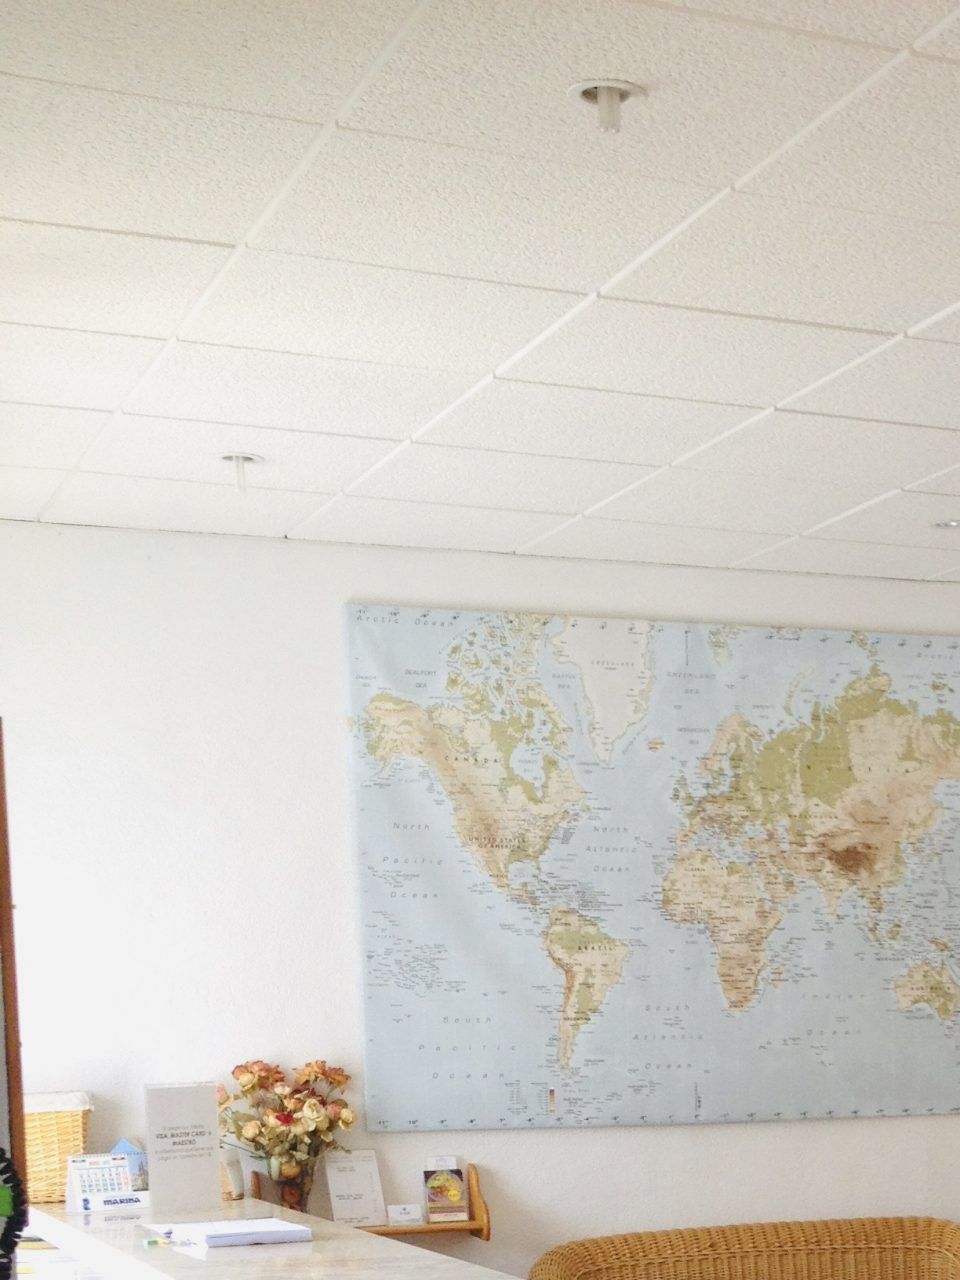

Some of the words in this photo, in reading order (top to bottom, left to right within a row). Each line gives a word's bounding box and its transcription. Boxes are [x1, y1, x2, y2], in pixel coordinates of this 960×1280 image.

[414, 617, 455, 627] Ocean
[445, 755, 499, 763] CANADA
[393, 823, 431, 832] North
[585, 845, 638, 853] Atlantic
[382, 855, 444, 865] Pacific
[592, 864, 631, 873] Ocean
[390, 891, 439, 899] Ocean
[442, 1015, 492, 1024] South
[418, 1044, 518, 1052] Pacific
[643, 1061, 693, 1070] Ocean
[432, 1071, 505, 1080] Ocean
